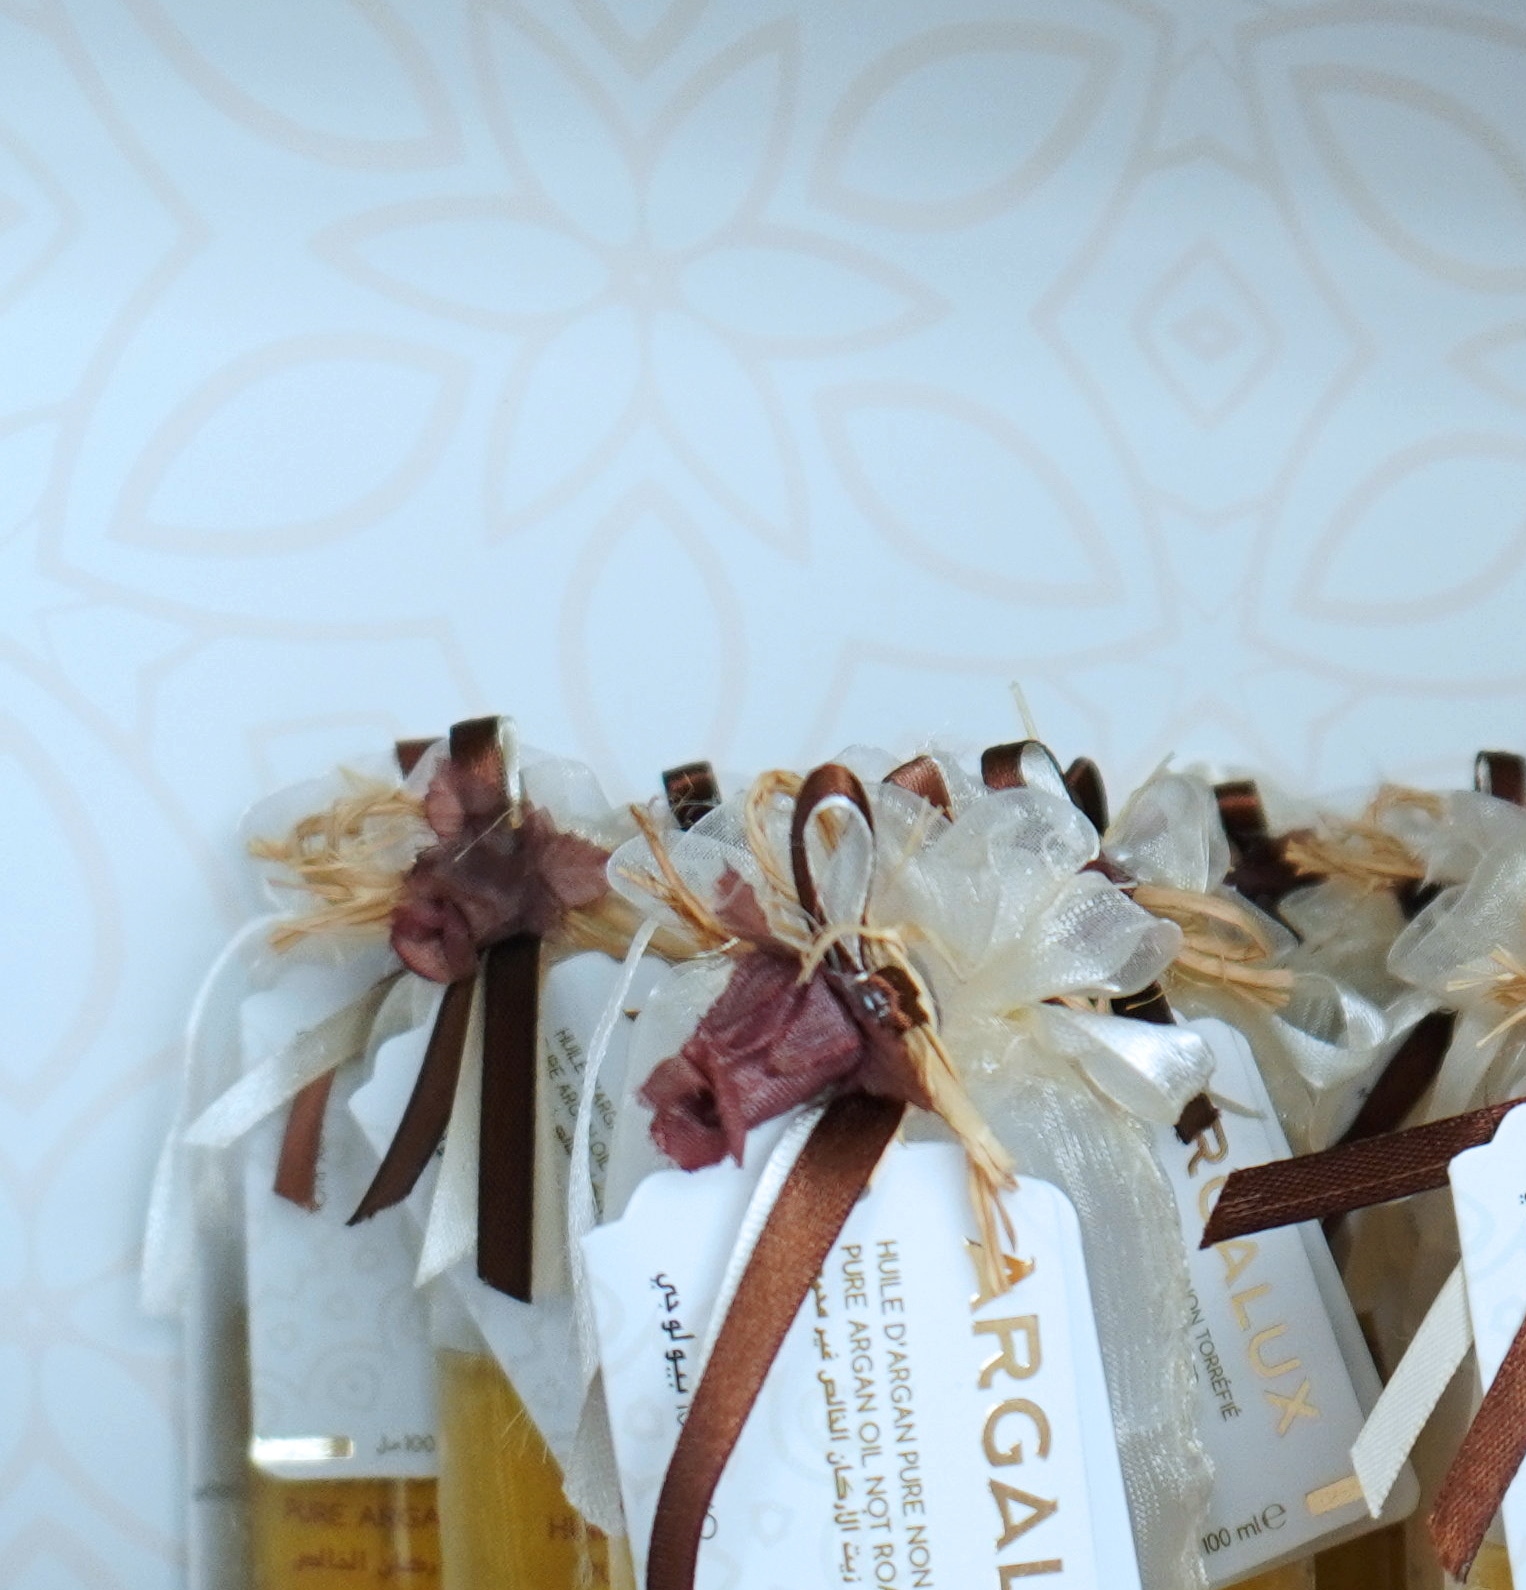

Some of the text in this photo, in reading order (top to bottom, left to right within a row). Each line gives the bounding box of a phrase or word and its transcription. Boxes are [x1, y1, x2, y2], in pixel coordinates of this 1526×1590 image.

[840, 1244, 866, 1307] PURE
[876, 1241, 904, 1313] HUILE
[654, 1273, 701, 1397] بيولوجي
[848, 1320, 876, 1413] ARGAN
[883, 1323, 916, 1443] D'ARGAN
[1194, 1328, 1241, 1424] TORRÉFIÉ
[858, 1421, 881, 1467] OIL
[865, 1476, 891, 1532] NOT
[898, 1451, 925, 1515] PURE
[842, 1542, 855, 1583] زيت
[906, 1525, 932, 1589] NON
